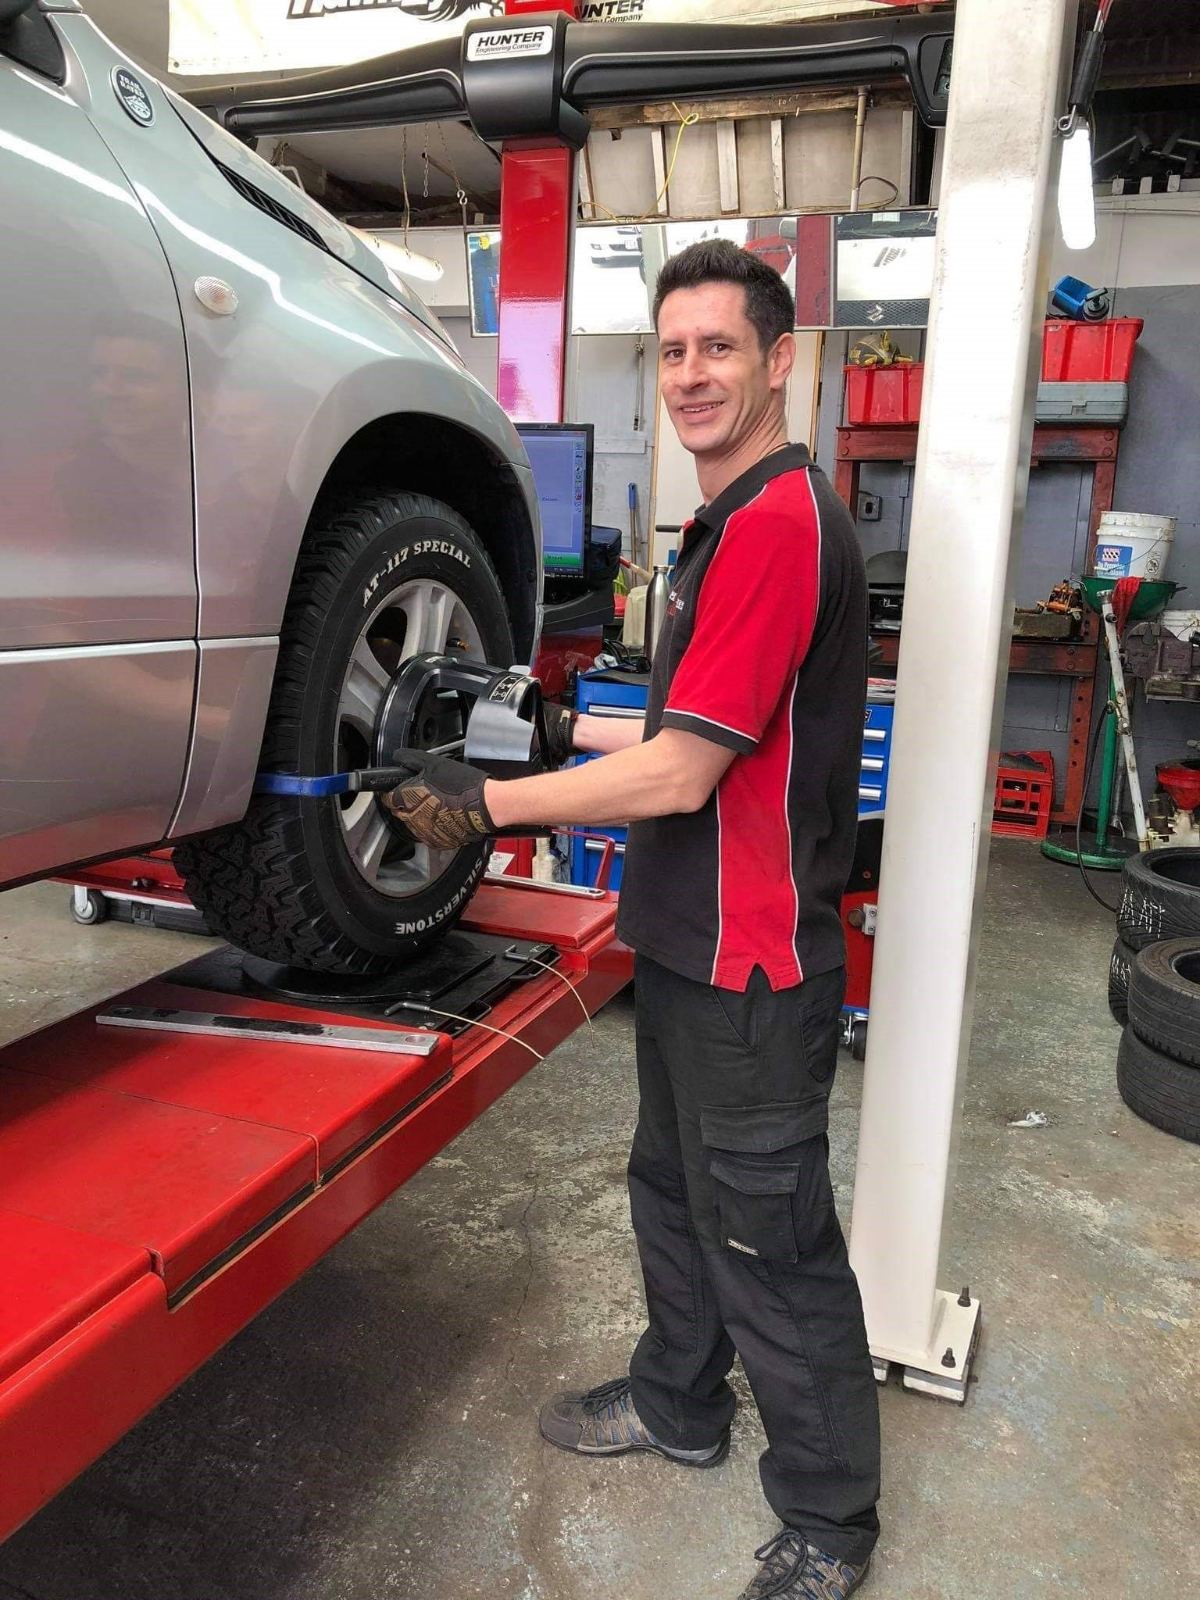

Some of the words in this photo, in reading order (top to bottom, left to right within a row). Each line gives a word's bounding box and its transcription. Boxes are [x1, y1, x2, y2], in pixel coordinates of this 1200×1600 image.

[577, 0, 645, 18] UNTER
[477, 31, 545, 47] HUNTER
[475, 45, 511, 53] Engineering
[363, 547, 409, 608] AT-117
[413, 540, 471, 568] SPECIAL
[395, 858, 483, 935] SILVERSTONE
